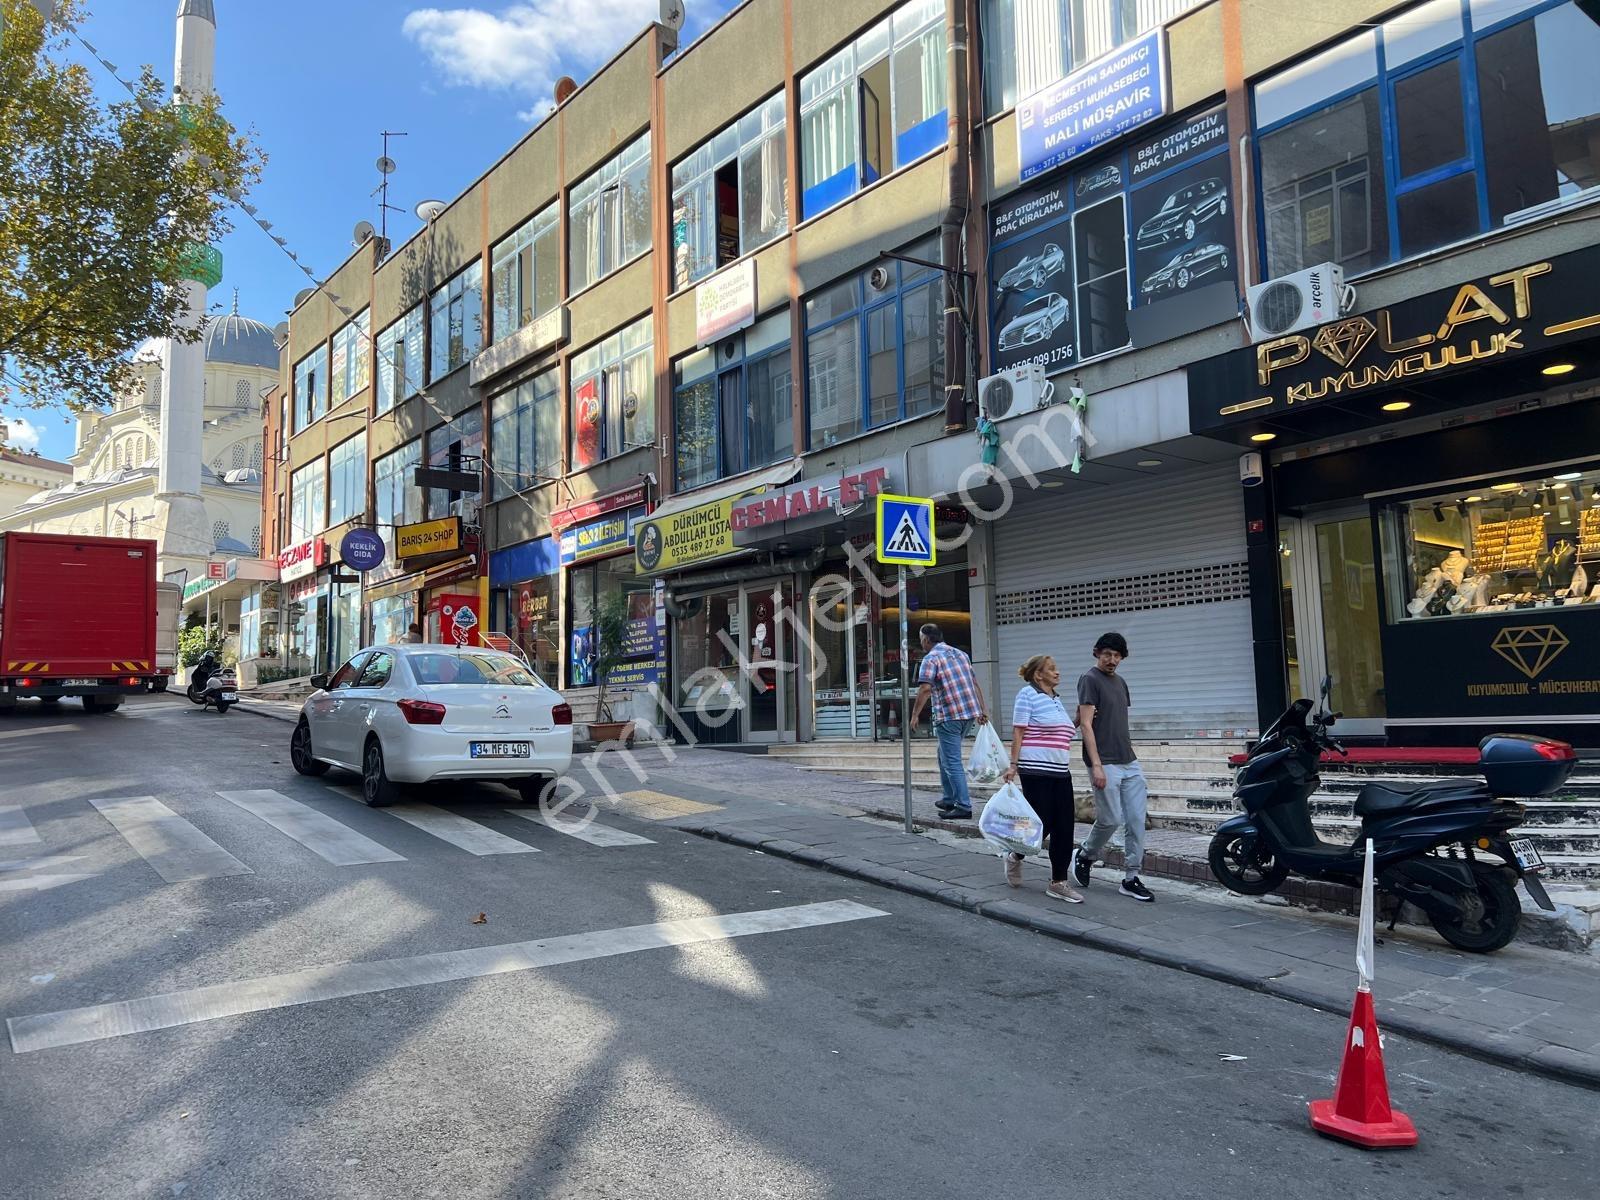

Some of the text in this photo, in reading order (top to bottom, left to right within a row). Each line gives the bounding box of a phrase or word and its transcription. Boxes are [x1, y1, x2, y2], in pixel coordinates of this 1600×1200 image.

[1100, 46, 1149, 80] SANDIKÇI
[1043, 63, 1150, 128] SERBEST MUHASEBECİ
[1044, 86, 1151, 149] MALİ MÜŞAVİR
[1043, 157, 1055, 169] 377
[1090, 127, 1114, 145] FAKS:
[1116, 119, 1130, 132] 377
[1131, 114, 1142, 125] 72
[1133, 124, 1225, 175] ARAÇ ALIM SATIM
[1137, 114, 1218, 160] B&F OTOMOTİV
[995, 200, 1064, 238] ARAÇ KİRALAMA
[996, 189, 1060, 226] B&F OTOMOTİV
[1313, 271, 1322, 309] arçelik
[1033, 352, 1049, 366] 099
[1051, 344, 1073, 362] 1756
[1287, 328, 1524, 405] KUYUMCULUK
[730, 467, 890, 532] CEMAL ET
[600, 517, 625, 541] İLETİŞİM
[673, 504, 721, 532] DÜRÜMCÜ
[349, 542, 376, 551] KEKLİK
[424, 533, 433, 543] 24
[434, 529, 454, 541] SHOP
[664, 519, 732, 549] ABDULLAH USTA
[671, 545, 688, 557] 0535
[690, 541, 703, 553] 489
[705, 539, 714, 549] 27
[715, 536, 725, 546] 68
[280, 540, 312, 570] ECZANE
[210, 564, 222, 577] E
[522, 595, 548, 613] BERBER
[609, 673, 645, 683] TEKNİK SERVİS
[1467, 683, 1529, 696] KUYUMCULUK
[476, 744, 528, 754] 34 MFG 403
